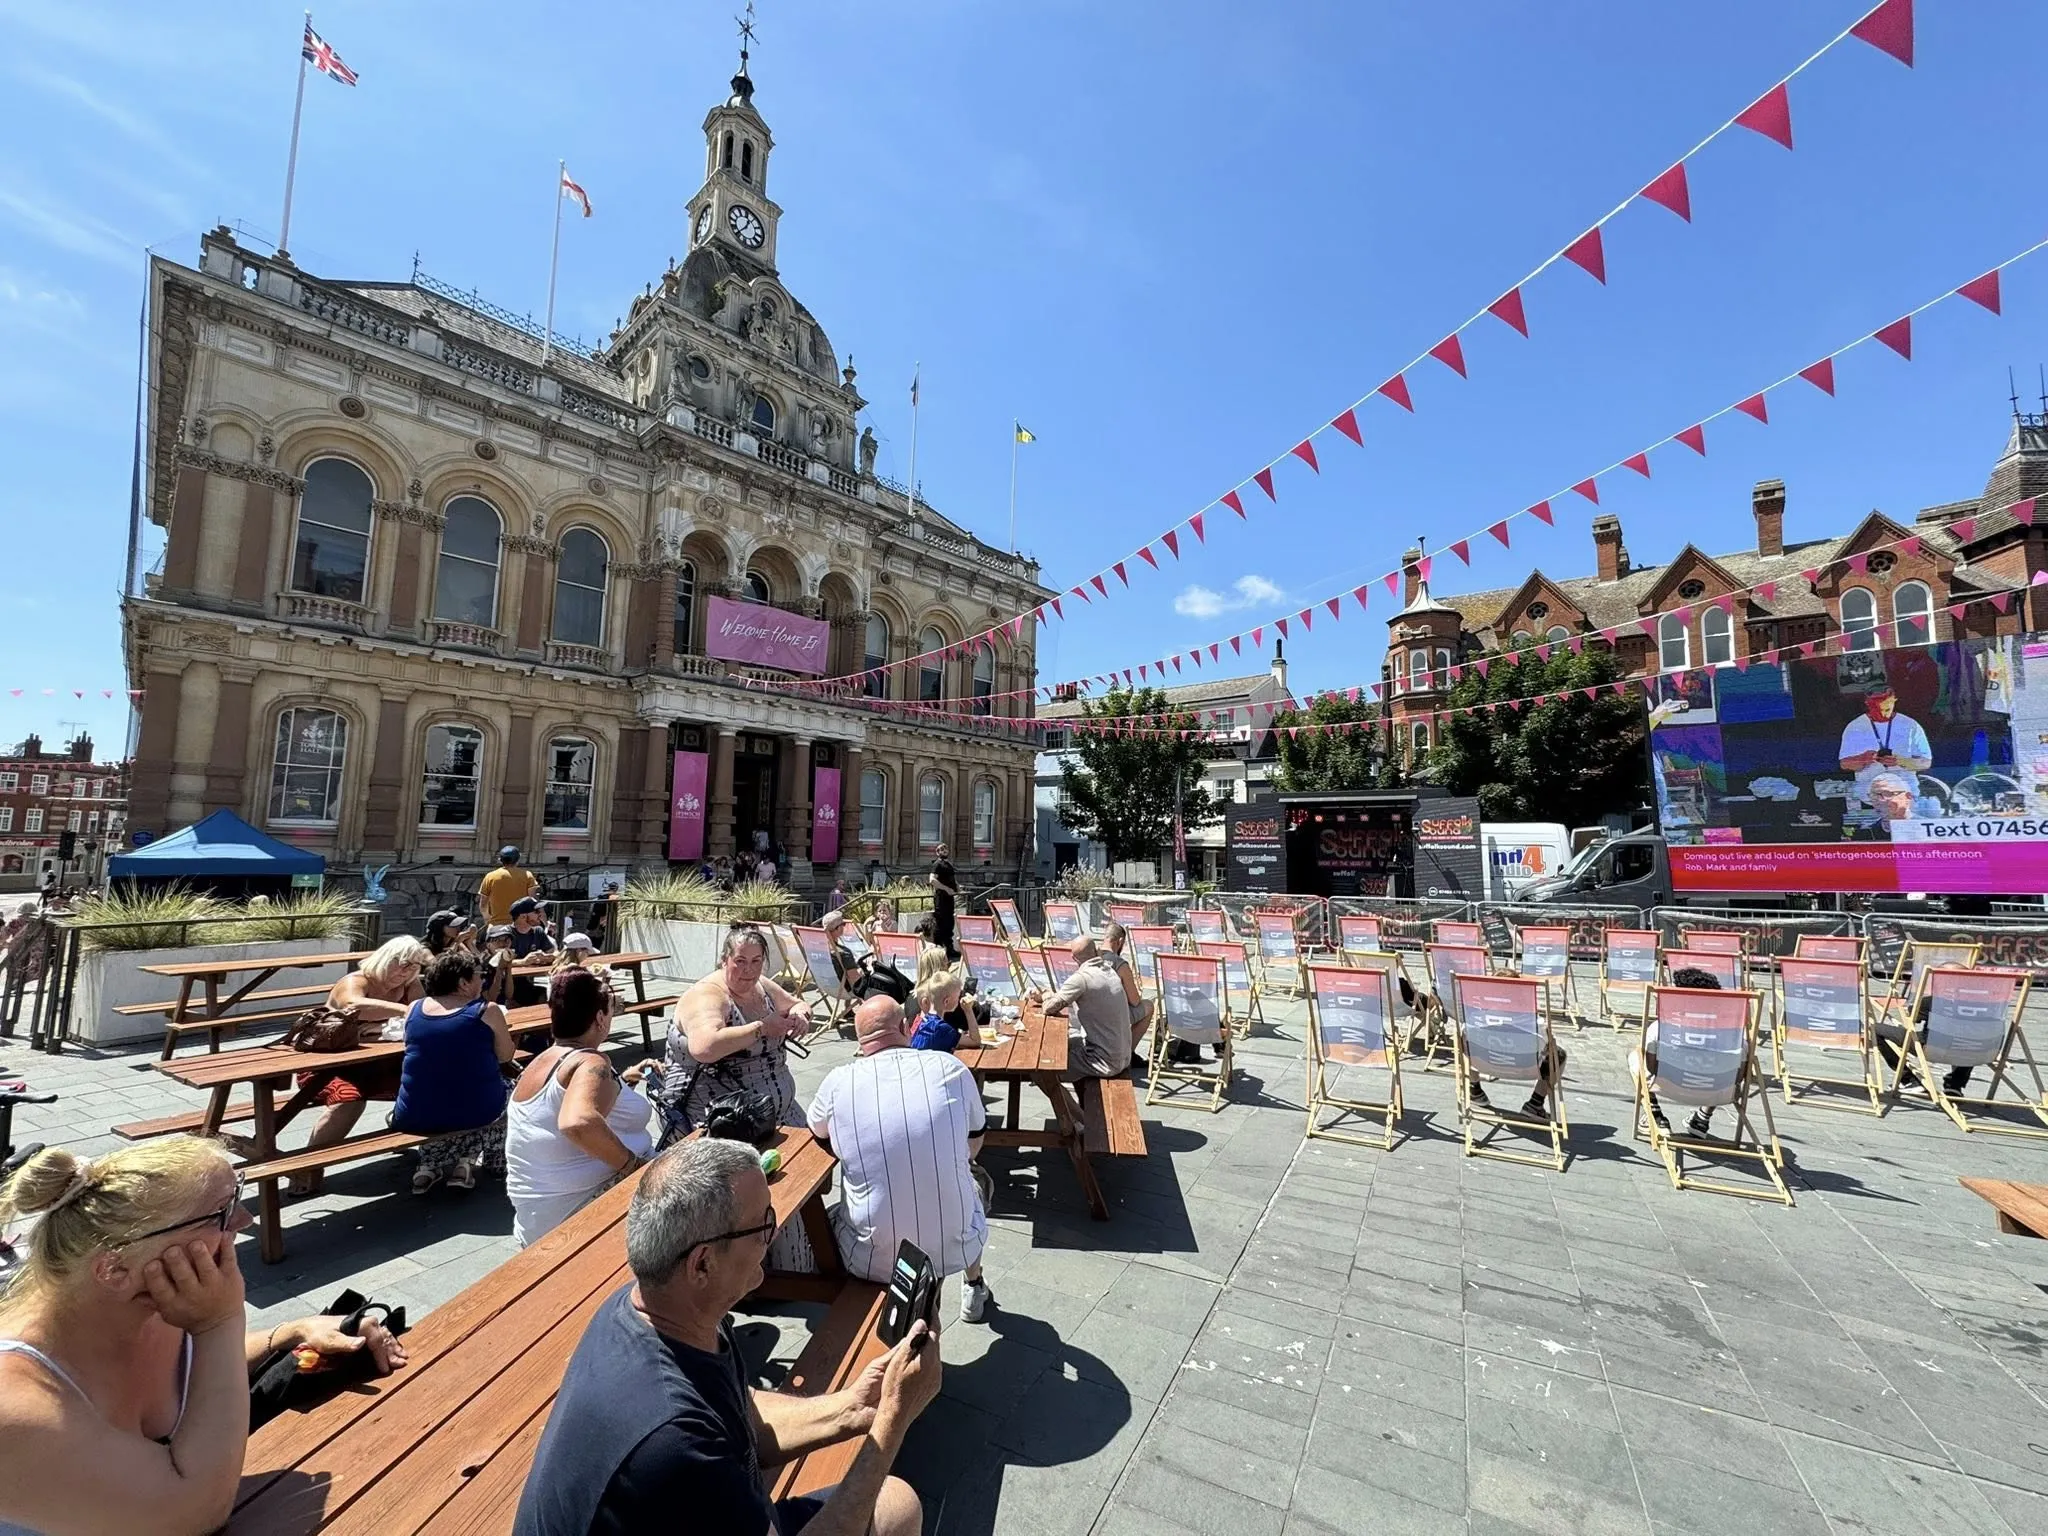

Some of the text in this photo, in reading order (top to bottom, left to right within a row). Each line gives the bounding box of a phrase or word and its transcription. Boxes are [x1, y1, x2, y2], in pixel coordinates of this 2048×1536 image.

[1924, 820, 2048, 838] Text 07456
[1683, 852, 1717, 861] Coming
[1736, 852, 1752, 860] live
[1753, 852, 1772, 860] and
[1773, 851, 1795, 860] loud
[1901, 850, 1923, 859] this
[1925, 849, 1983, 859] afternoon
[1706, 863, 1727, 871] Mark
[1729, 863, 1747, 871] and
[1748, 862, 1778, 872] family
